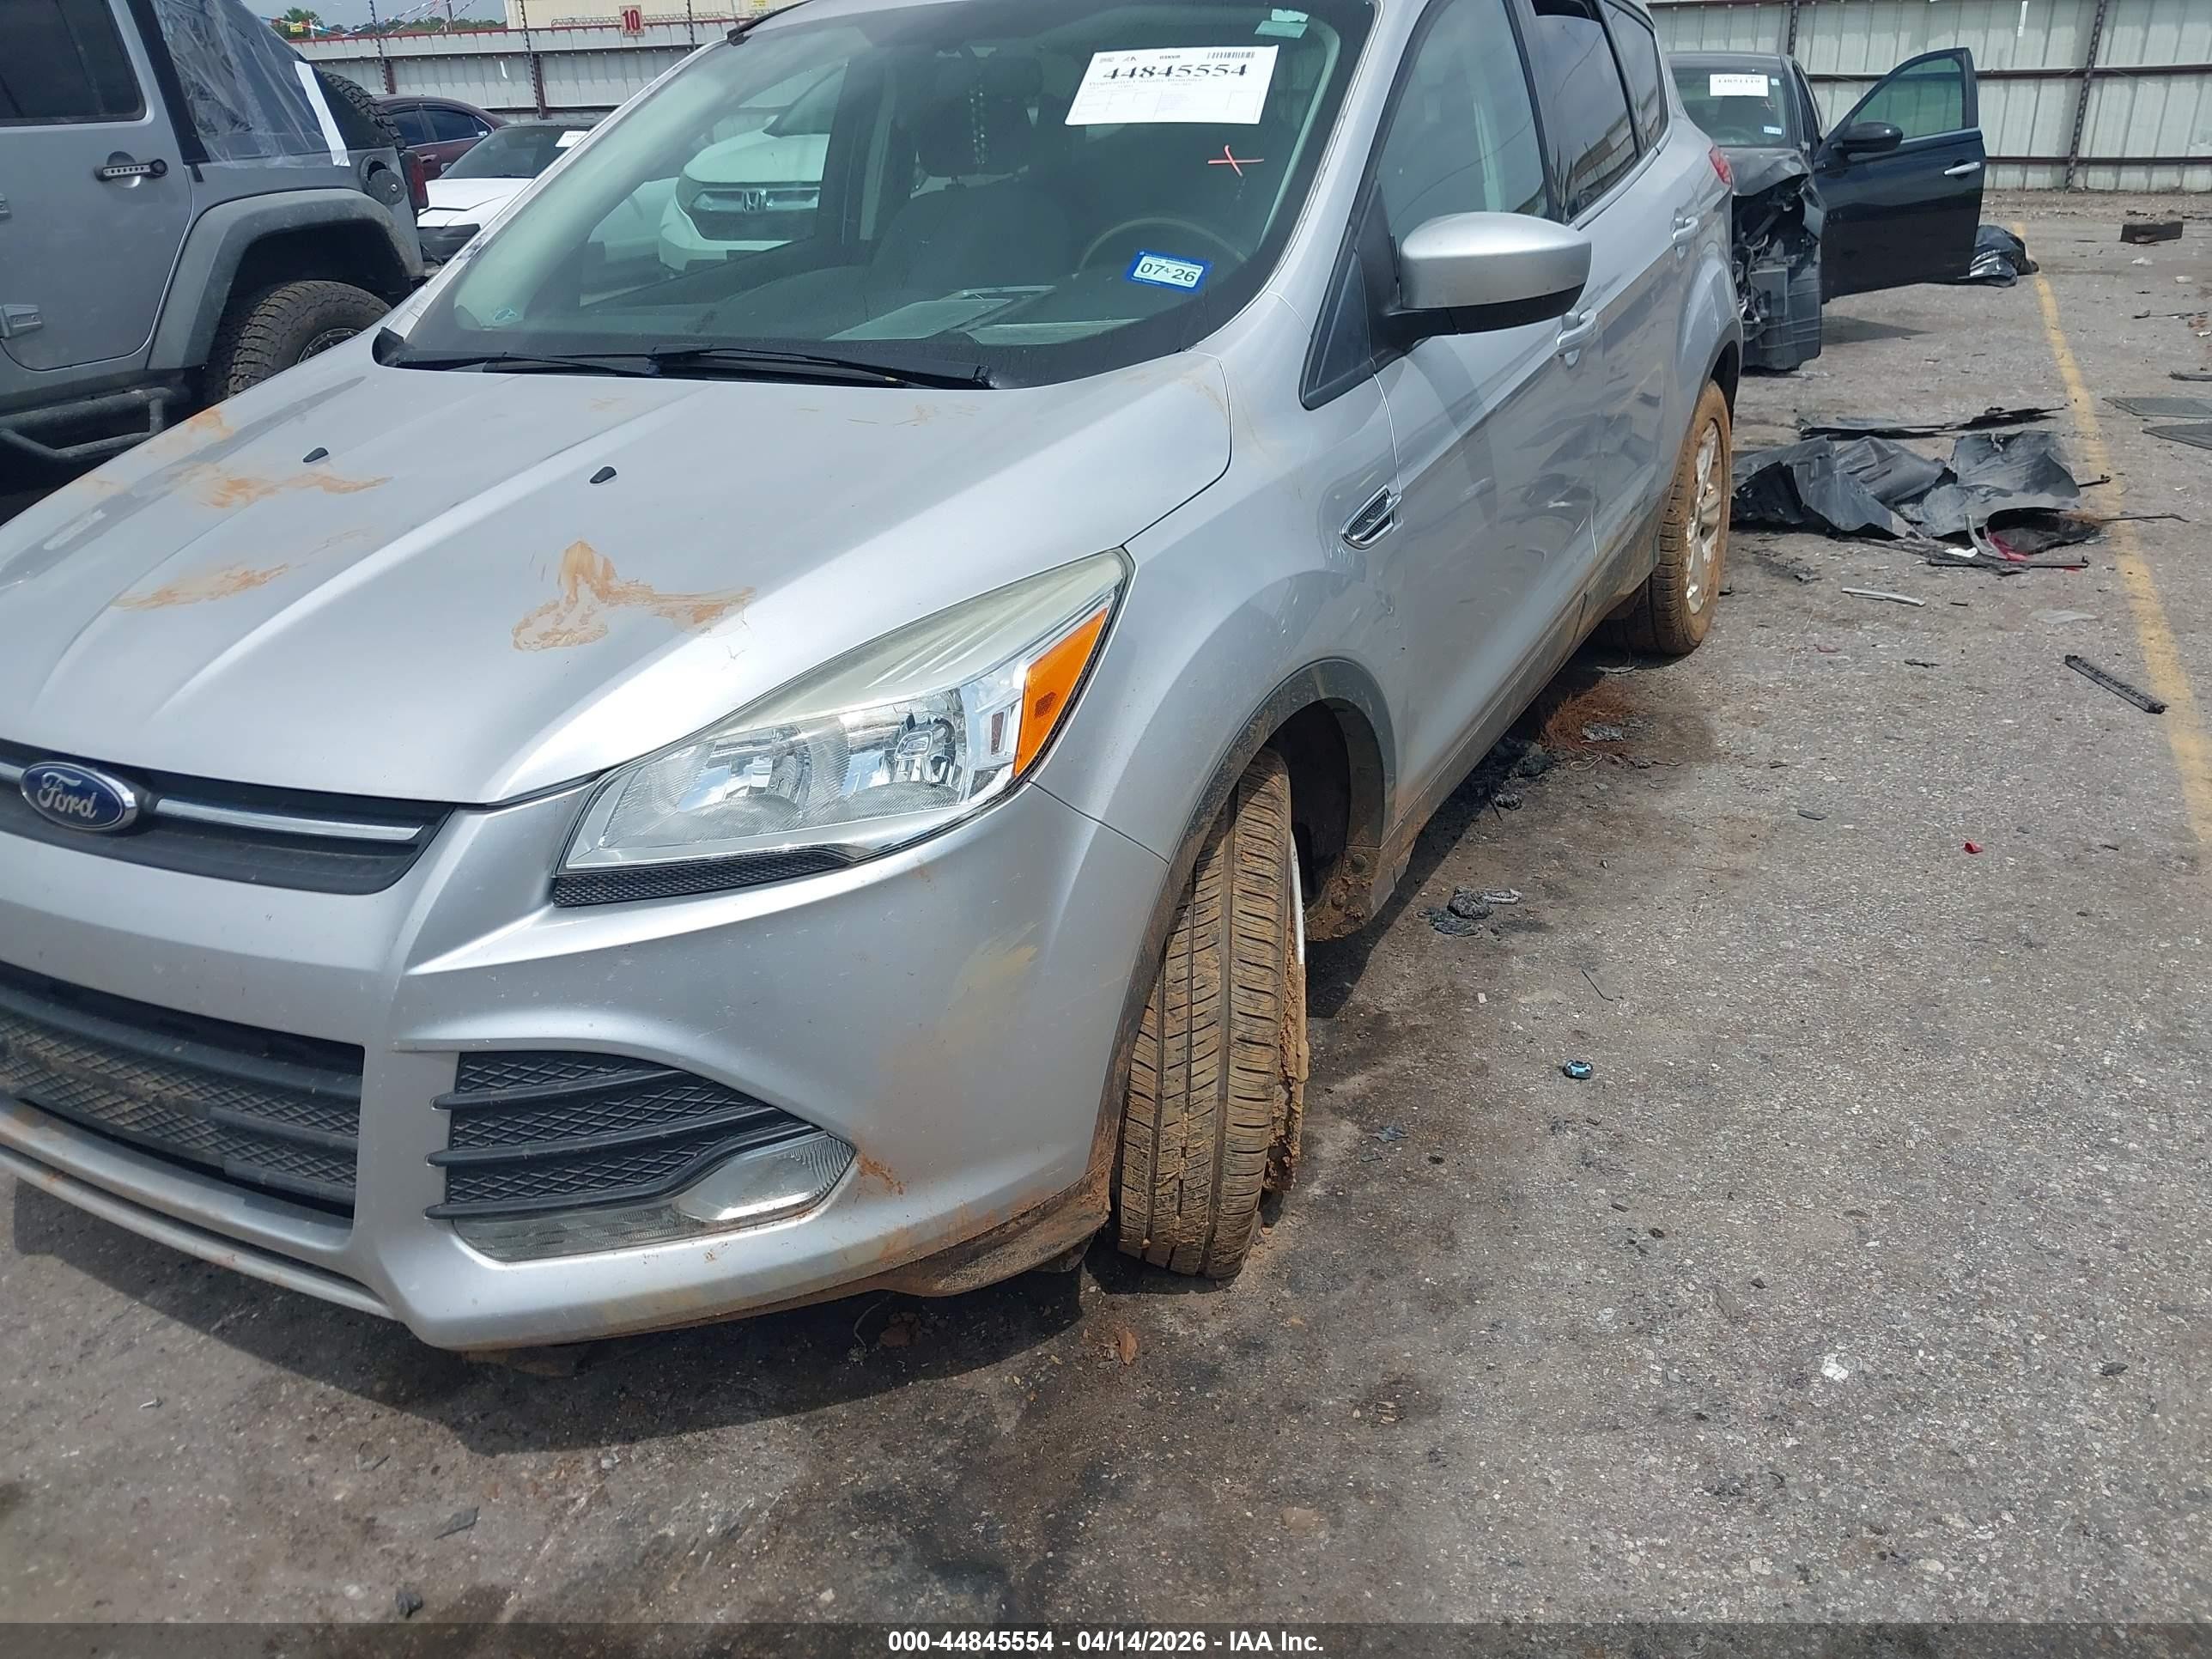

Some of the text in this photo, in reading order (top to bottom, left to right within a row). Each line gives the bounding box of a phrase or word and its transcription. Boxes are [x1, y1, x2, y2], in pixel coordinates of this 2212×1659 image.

[623, 9, 641, 31] 10
[1103, 64, 1248, 80] 44845554
[1171, 268, 1197, 282] 26
[37, 772, 98, 818] Ford
